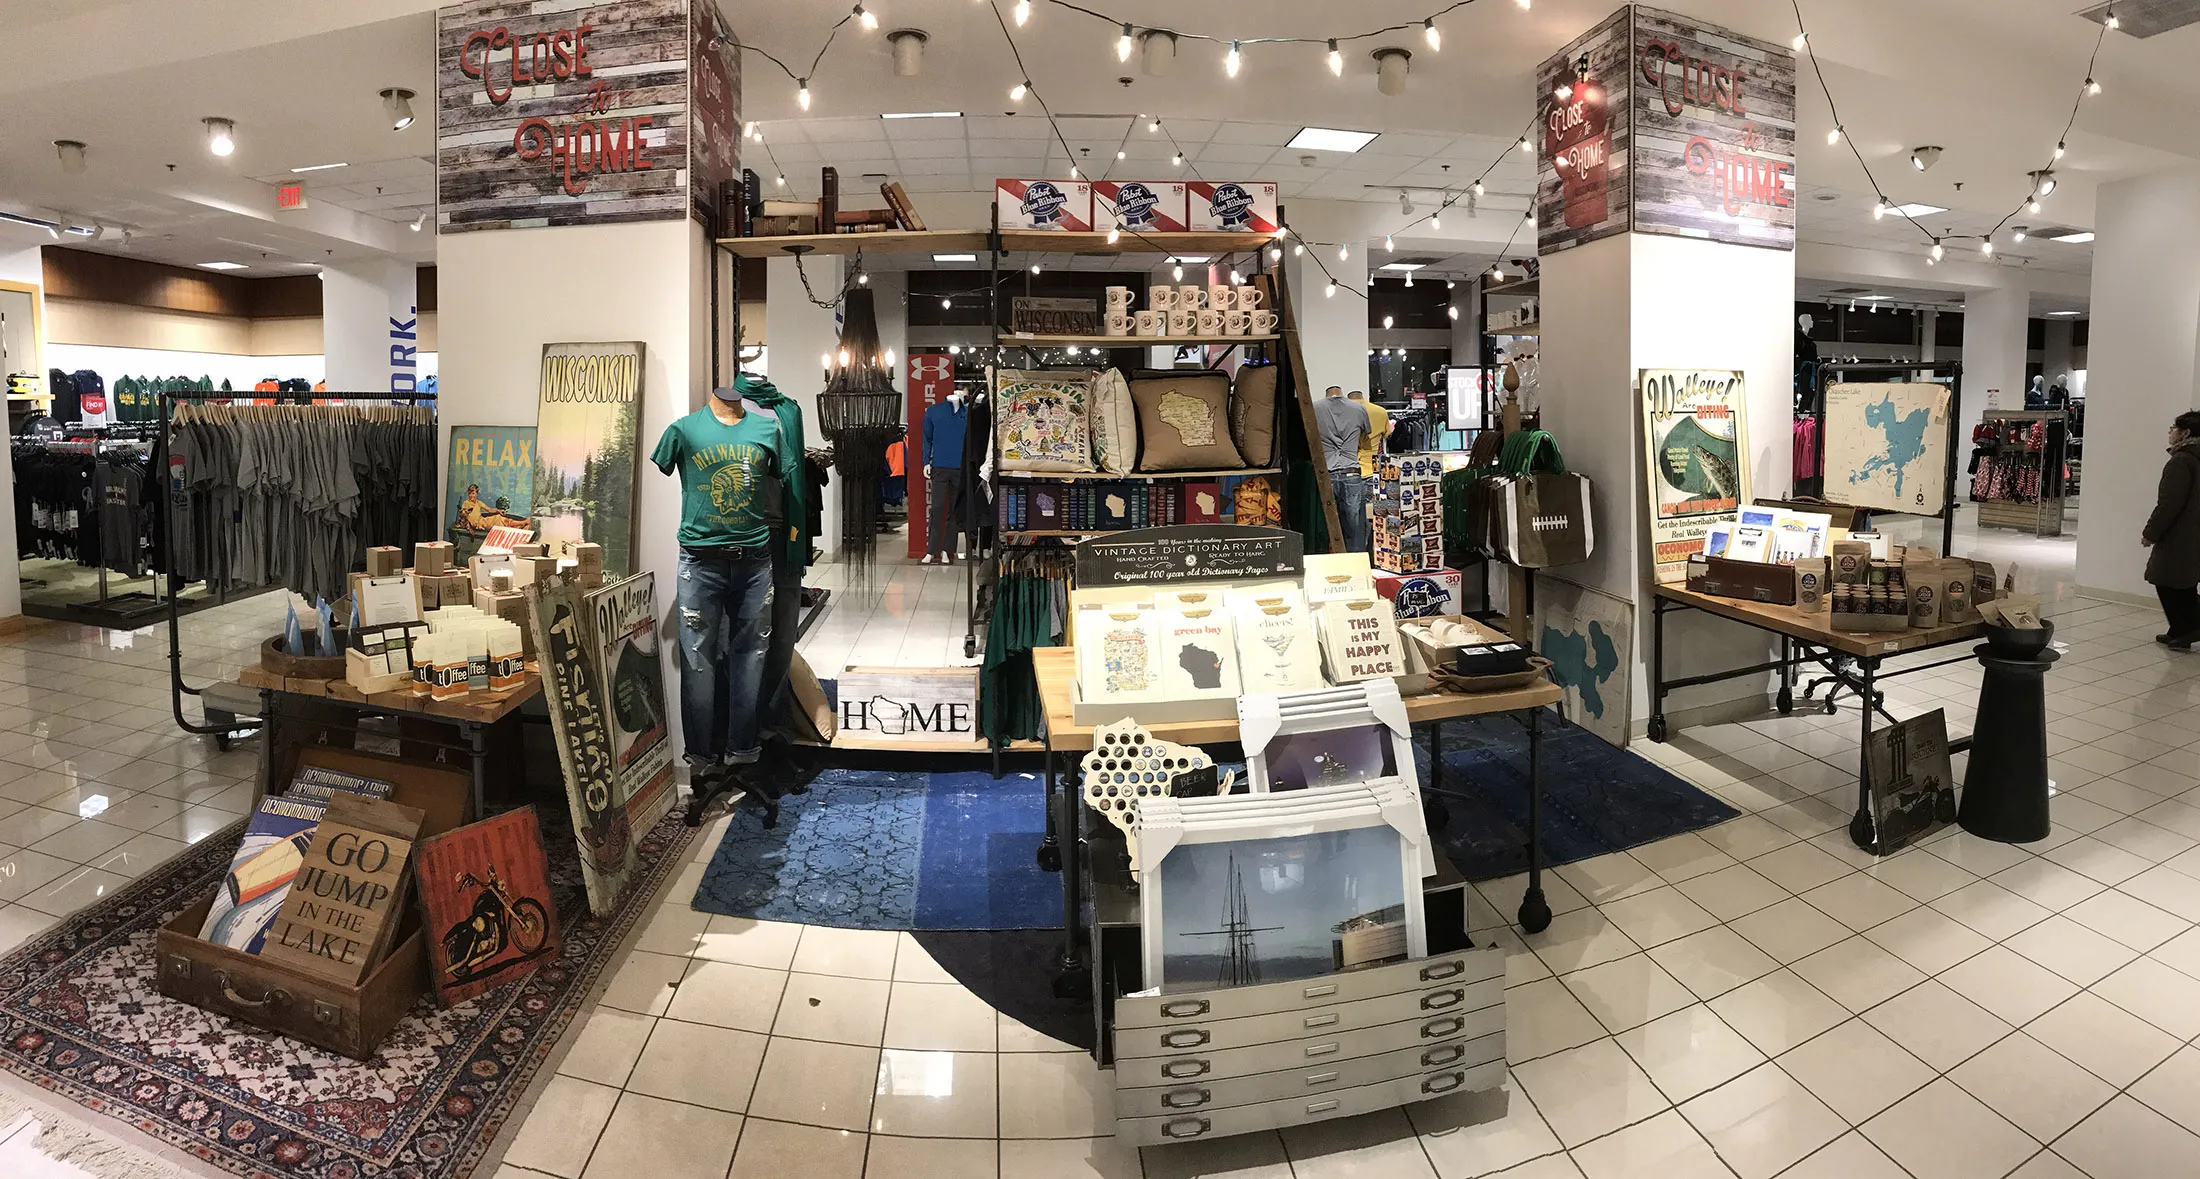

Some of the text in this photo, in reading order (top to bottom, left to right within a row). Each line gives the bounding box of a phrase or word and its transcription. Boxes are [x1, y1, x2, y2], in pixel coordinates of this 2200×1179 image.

[460, 25, 593, 105] CLOSE
[1642, 39, 1747, 117] CLOSE
[1549, 100, 1584, 141] CLOSE
[513, 116, 654, 197] HOME
[1568, 140, 1605, 180] HOME
[1684, 135, 1790, 216] HOME
[280, 186, 302, 207] EXIT
[1028, 187, 1051, 201] Pabst
[1120, 187, 1142, 202] Pabst
[1216, 189, 1238, 202] Pabst
[1022, 196, 1066, 214] Blue Ribbon
[1114, 196, 1157, 215] Blue Ribbon
[1211, 198, 1252, 216] Blue Ribbon
[1014, 299, 1030, 309] ON
[1015, 310, 1096, 333] WISCONSIN
[545, 353, 637, 403] WISCONSIN
[1000, 382, 1085, 405] WISCONSIN
[1647, 373, 1736, 422] Walleye!
[1697, 404, 1730, 419] BITING
[455, 438, 533, 468] RELAX
[1657, 521, 1668, 530] Get
[1669, 520, 1679, 528] the
[1679, 516, 1718, 528] Indescribable
[1094, 541, 1282, 557] VINTAGE DICTIONARY ART
[1113, 570, 1148, 582] Original
[1150, 570, 1165, 580] 100
[1166, 572, 1185, 581] year
[1186, 567, 1200, 577] old
[1202, 566, 1244, 577] Dictionary
[1245, 565, 1269, 575] Pages
[1445, 574, 1460, 584] 30
[599, 582, 654, 657] Walleye!
[1347, 618, 1379, 630] THIS
[1174, 625, 1222, 636] green bay
[1362, 631, 1380, 642] MY
[1345, 644, 1391, 658] HAPPY
[1350, 662, 1394, 676] PLACE
[1179, 772, 1207, 788] BEER
[325, 832, 390, 874] GO
[297, 866, 389, 910] JUMP
[296, 900, 365, 933] IN THE
[278, 922, 361, 966] LAKE
